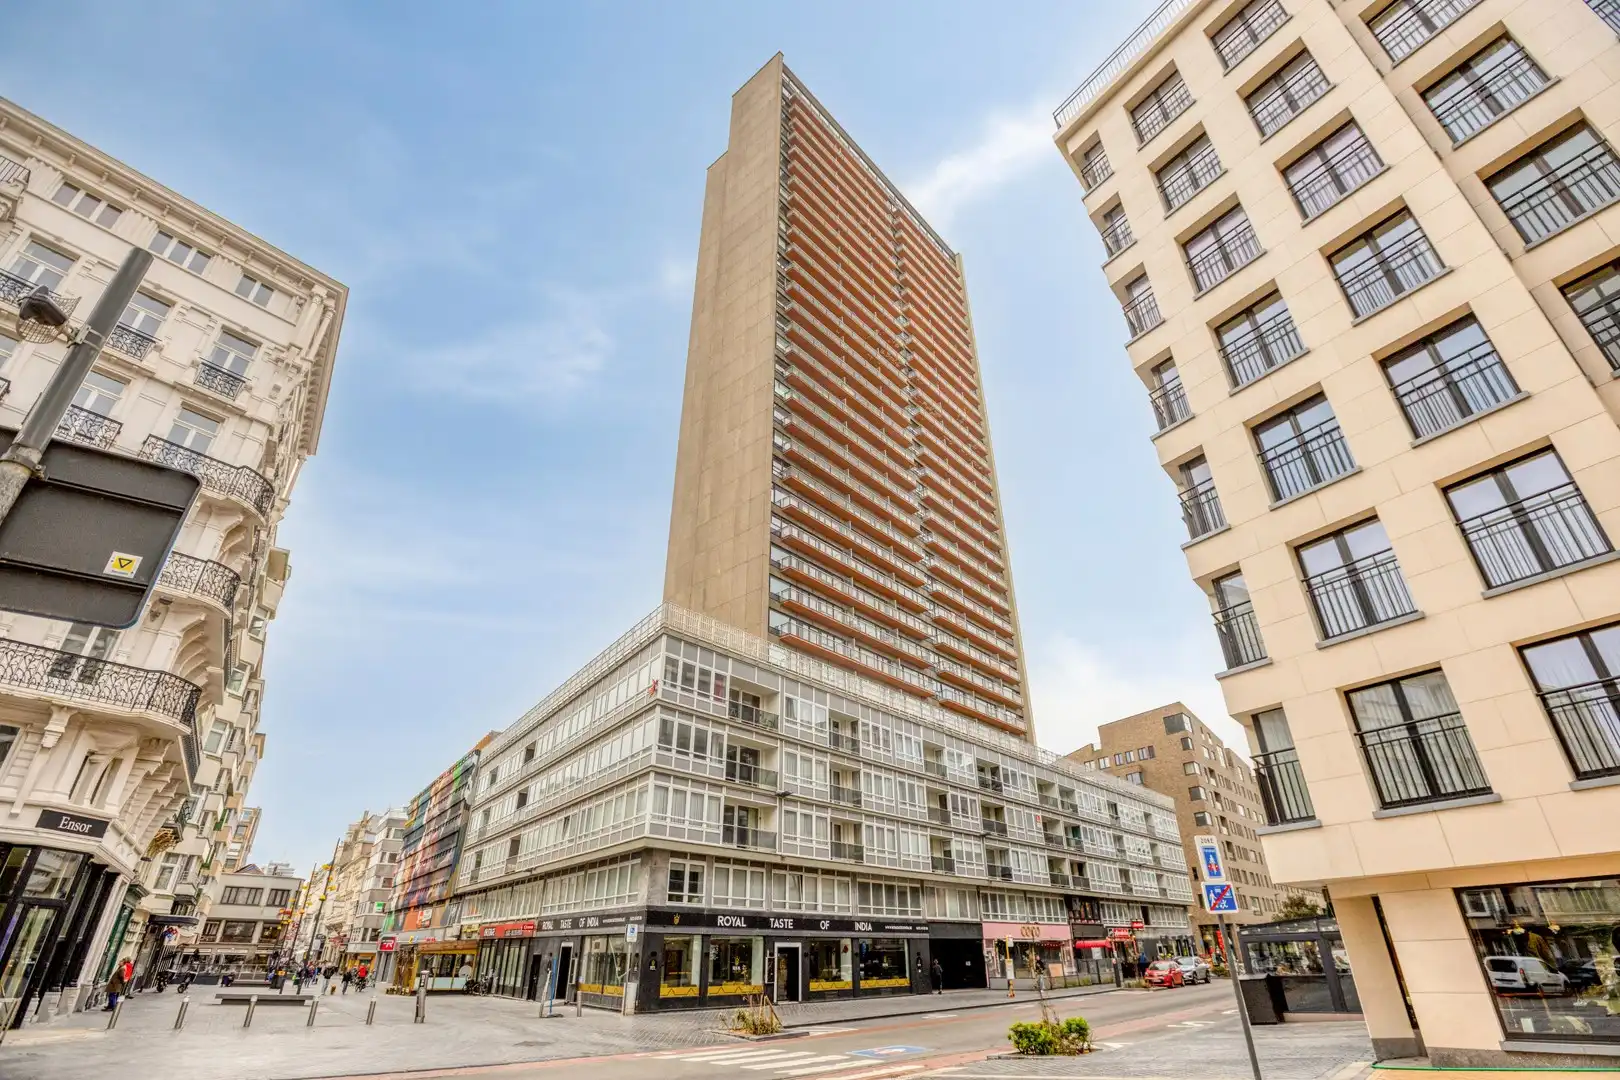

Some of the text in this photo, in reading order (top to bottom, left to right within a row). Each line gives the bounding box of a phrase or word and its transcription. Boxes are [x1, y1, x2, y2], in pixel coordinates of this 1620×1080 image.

[58, 816, 92, 833] Ensor
[542, 920, 553, 930] ROYAL
[560, 918, 572, 929] TASTE
[579, 917, 586, 928] OF
[587, 916, 599, 928] INDIA
[717, 915, 747, 927] ROYAL
[769, 917, 794, 929] TASTE
[820, 920, 830, 930] OF
[854, 921, 873, 931] INDIA
